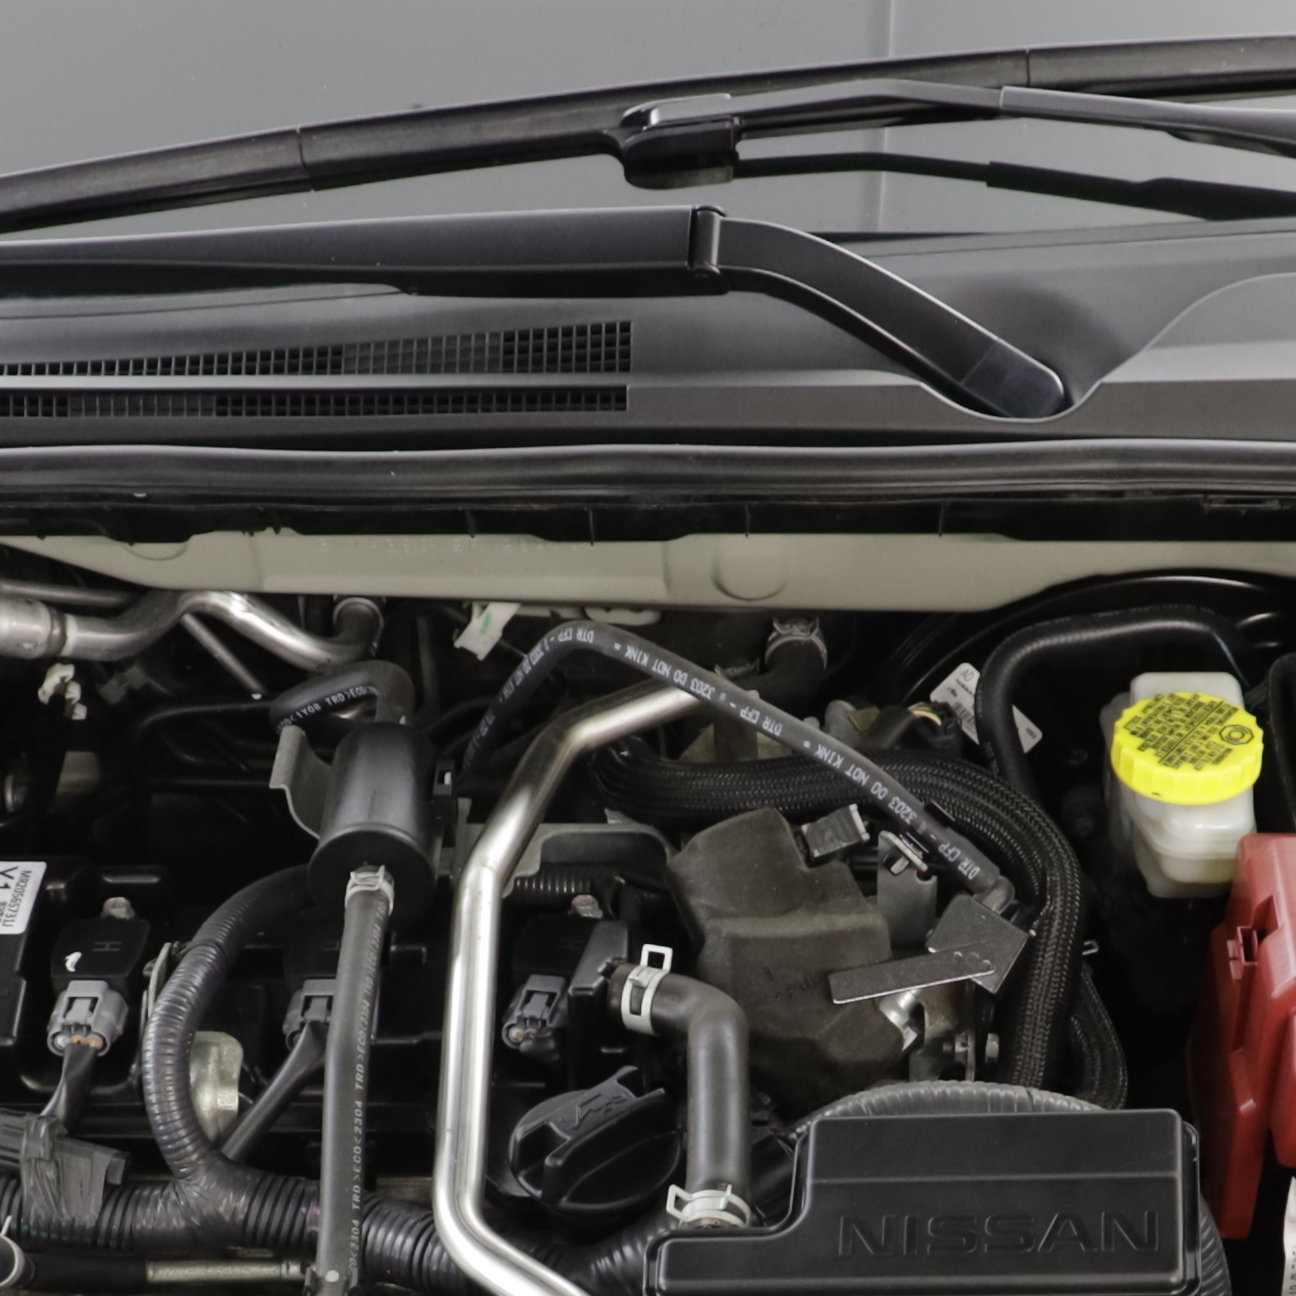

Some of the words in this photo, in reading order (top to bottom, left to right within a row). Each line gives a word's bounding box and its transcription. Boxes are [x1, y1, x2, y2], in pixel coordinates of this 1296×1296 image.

[624, 645, 650, 666] KINK
[653, 660, 672, 678] NOT
[673, 669, 688, 685] DO
[690, 678, 716, 700] 3203
[740, 707, 761, 724] CFP
[762, 718, 783, 737] DTR
[814, 744, 845, 769] KINK
[844, 764, 871, 787] NOT
[870, 781, 889, 800] DO
[888, 796, 918, 824] 3203
[836, 1209, 1159, 1258] NISSAN
